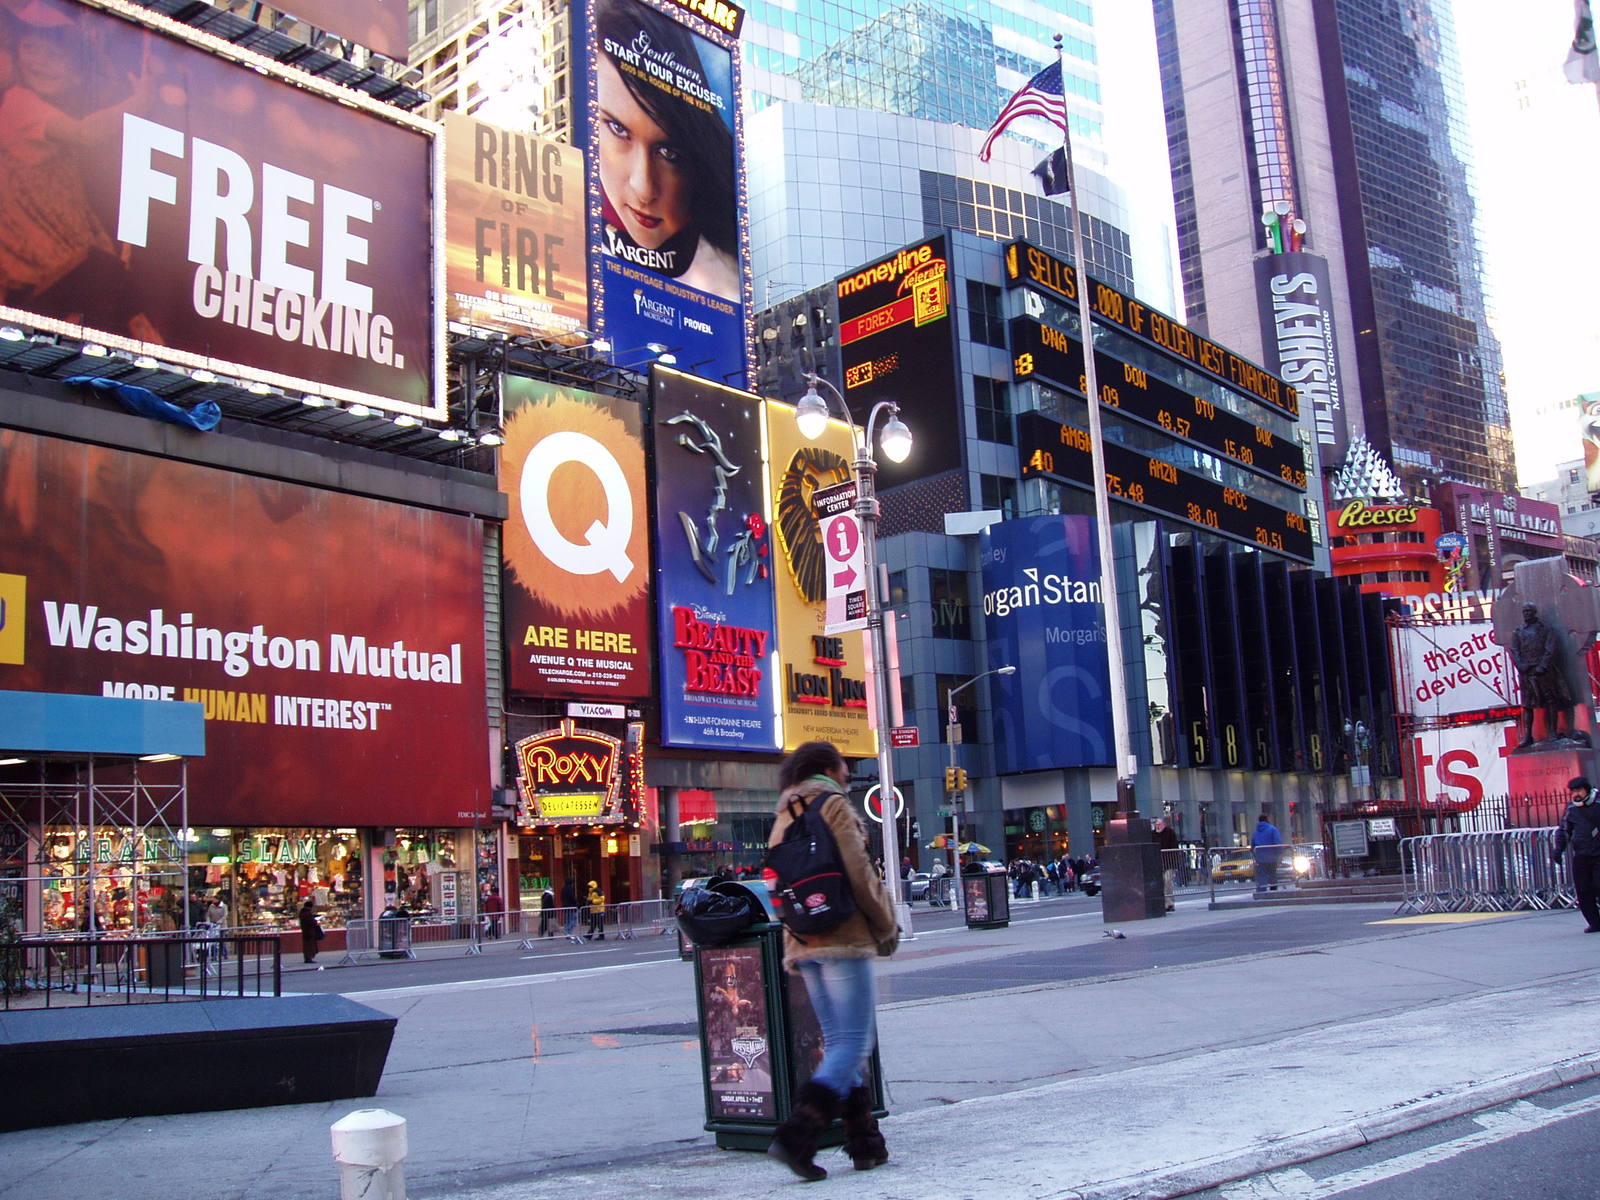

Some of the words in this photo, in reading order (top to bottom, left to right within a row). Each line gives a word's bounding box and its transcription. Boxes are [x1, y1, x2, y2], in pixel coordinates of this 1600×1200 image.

[631, 30, 702, 83] Gentlemen,
[604, 38, 641, 67] START
[643, 57, 674, 84] YOUR
[676, 75, 727, 110] EXCUSES.
[475, 122, 563, 205] RING
[501, 199, 528, 215] OF
[475, 217, 564, 300] FIRE
[613, 238, 676, 269] ARGENT
[606, 259, 622, 275] THE
[623, 266, 664, 290] MORTGAGE
[665, 280, 706, 305] INDUSTRY'S
[706, 298, 736, 316] LEADER.
[837, 244, 933, 299] moneyline
[193, 264, 404, 369] CHECKING.
[640, 295, 676, 318] ARGENT
[643, 311, 674, 327] MORTGAGE
[857, 308, 895, 335] FOREX
[683, 316, 714, 335] PROVEN.
[1027, 247, 1076, 300] SELLS
[1128, 301, 1146, 334] OF
[1150, 313, 1195, 362] GOLDEN
[1198, 337, 1226, 377] WEST
[1229, 355, 1284, 408] FINANCIAL
[1322, 309, 1336, 377] Chocolate
[1040, 324, 1069, 354] DNA
[1123, 363, 1149, 391] DOW
[1255, 426, 1274, 449] DUK
[1328, 377, 1341, 411] Milk
[1157, 408, 1192, 438] 43.57
[1224, 437, 1254, 465] 15.80
[1060, 423, 1093, 453] AMGN
[1148, 457, 1179, 486] AMZN
[519, 431, 634, 584] Q
[816, 488, 857, 508] INFORMATION
[826, 500, 850, 514] CENTER
[1105, 473, 1145, 504] 75.48
[1187, 502, 1221, 529] 38.01
[1255, 526, 1284, 551] 20.51
[1337, 500, 1420, 528] Reese's
[690, 602, 727, 624] Disney's
[43, 600, 321, 678] Washington
[329, 634, 463, 685] Mutual
[523, 625, 569, 649] ARE
[575, 629, 638, 655] HERE.
[673, 605, 769, 658] BEAUTY
[811, 635, 844, 660] THE
[530, 654, 565, 666] AVENUE
[567, 658, 575, 667] Q
[576, 658, 594, 668] THE
[595, 660, 634, 671] MUSICAL
[538, 668, 587, 678] TELECHARGE.COM
[684, 649, 763, 697] BEAST
[709, 652, 734, 664] AND
[735, 655, 757, 668] THE
[785, 663, 830, 703] LION
[184, 688, 268, 724] HUMAN
[581, 706, 613, 716] VIACOM
[715, 728, 720, 736] &
[720, 728, 745, 740] Broadway
[741, 719, 762, 729] THEATRE
[1193, 721, 1205, 764] 5
[542, 800, 599, 812] DELICATESSEN
[77, 838, 187, 864] GRAND
[240, 838, 318, 864] SLAM
